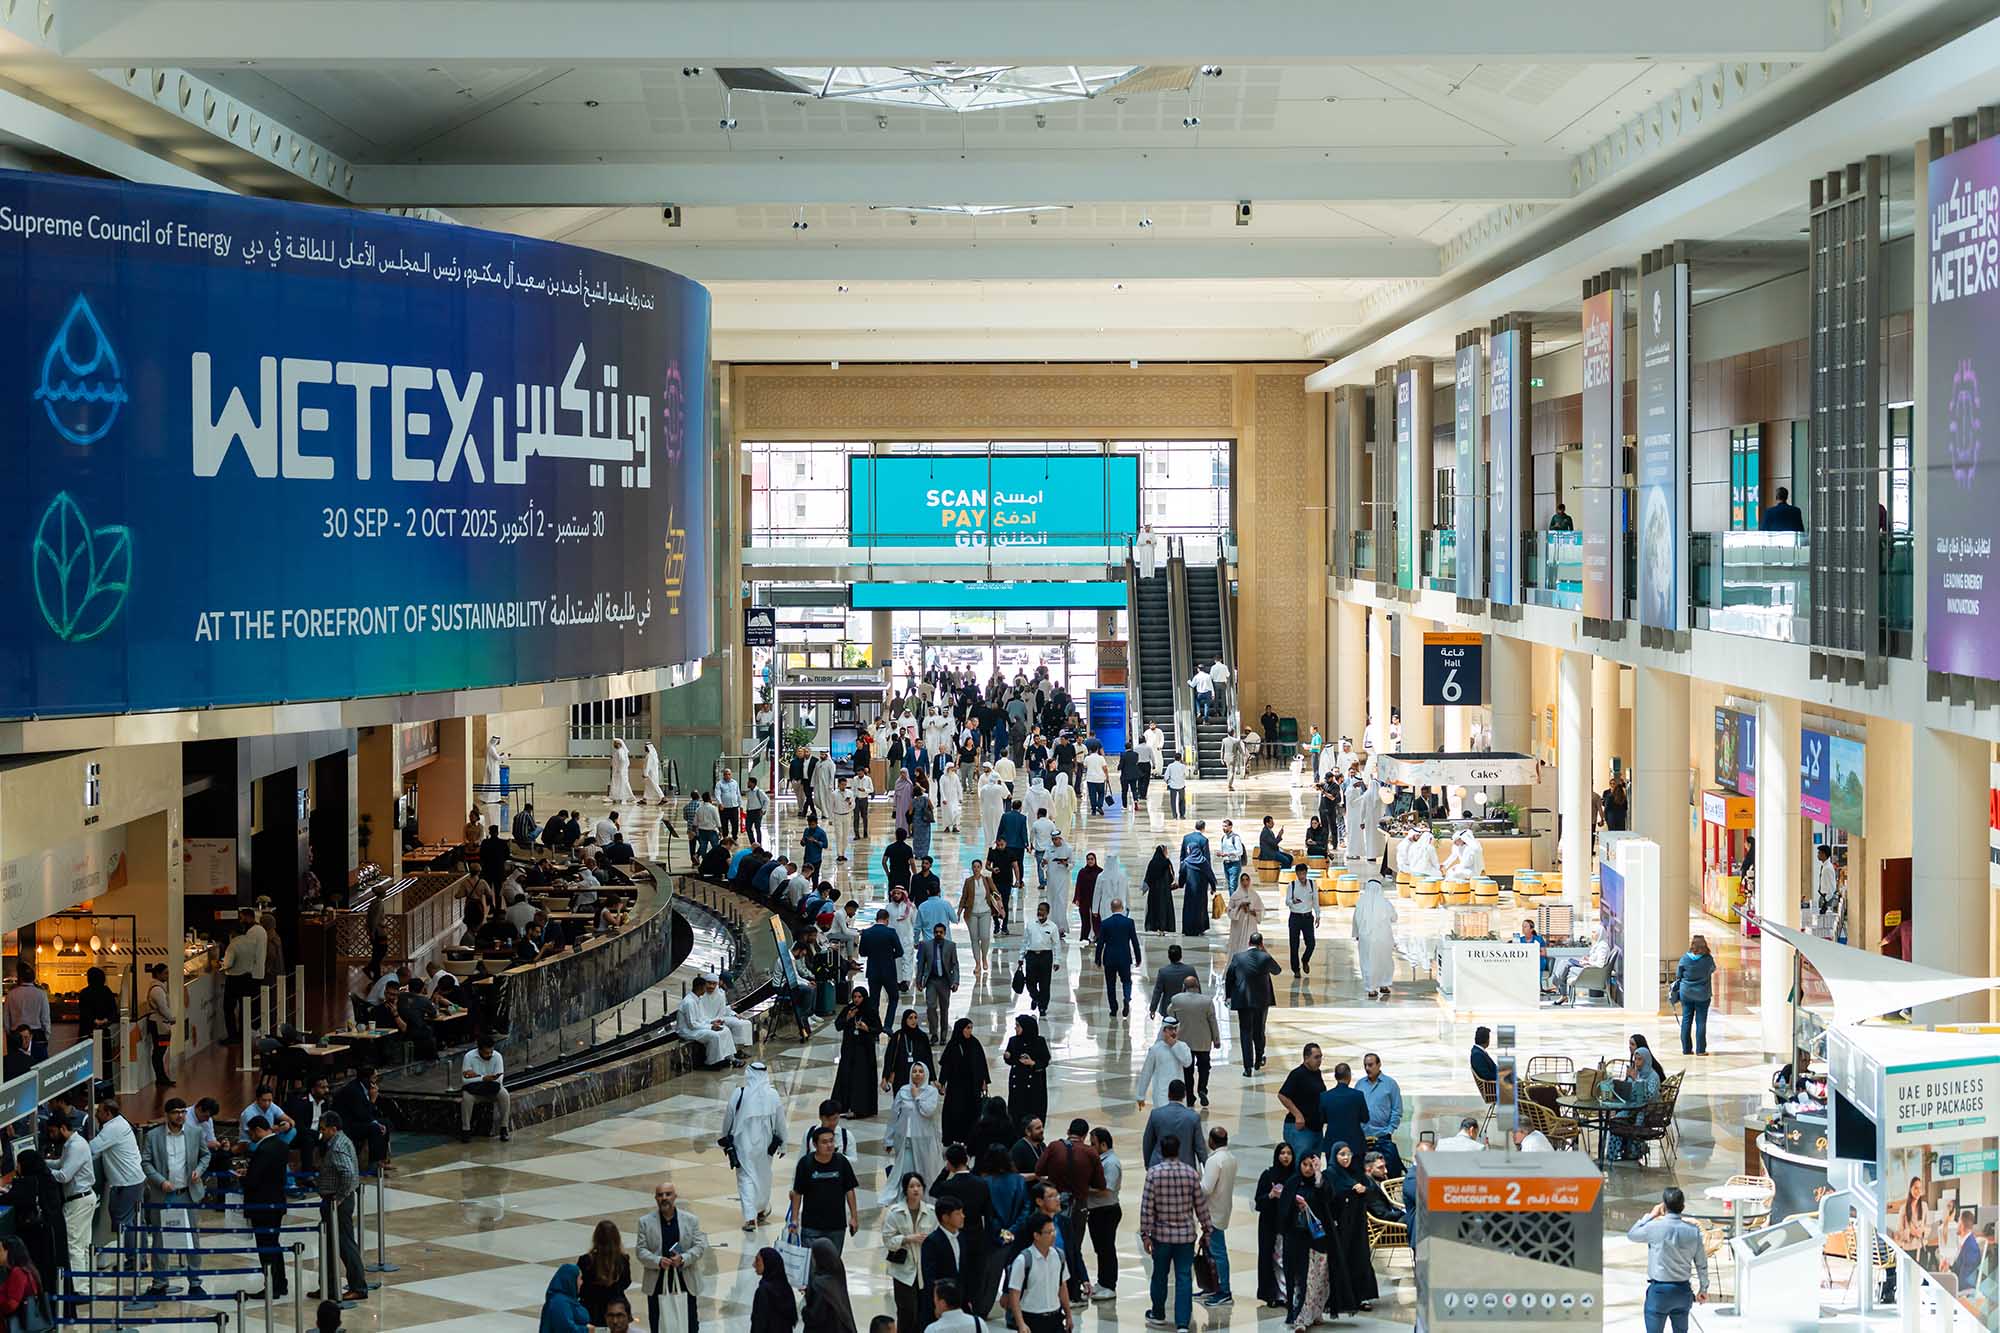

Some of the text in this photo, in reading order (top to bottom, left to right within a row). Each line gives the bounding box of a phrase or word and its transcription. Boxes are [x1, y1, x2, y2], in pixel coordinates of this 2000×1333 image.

[0, 206, 232, 257] Supreme Council of Energy
[242, 239, 264, 265] دبي
[268, 231, 282, 267] في
[285, 235, 336, 262] للطاقة
[338, 240, 376, 269] الأعلى
[378, 249, 430, 276] المجلس
[433, 257, 461, 282] رئيس
[504, 261, 515, 289] آل
[1931, 241, 1986, 305] WETEX
[516, 274, 546, 292] سعيد
[547, 278, 560, 297] بن
[561, 270, 583, 296] أحمد
[191, 351, 486, 484] WETEX
[493, 342, 651, 489] ويتكس
[926, 489, 987, 507] SCAN
[993, 490, 1043, 506] امسح
[322, 508, 348, 538] 30
[353, 508, 388, 538] SEP
[406, 508, 417, 538] 2
[421, 508, 456, 538] OCT
[461, 508, 498, 538] 2025
[499, 499, 535, 545] أكتوبر
[537, 510, 545, 537] 2
[556, 513, 591, 544] سبتمبر
[592, 510, 606, 538] 30
[942, 509, 986, 527] PAY
[993, 511, 1037, 527] ادفع
[955, 530, 987, 548] GO
[550, 589, 651, 635] في طليعة الاستدامة
[1947, 598, 1980, 616] INNOVATIONS
[195, 600, 547, 642] AT THE FOREFRONT OF SUSTAINABILITY
[1440, 648, 1465, 657] قاعة
[1442, 669, 1462, 702] 6
[1470, 769, 1499, 779] Cakes
[1468, 950, 1529, 958] TRUSSARDI
[1898, 1078, 1984, 1101] UAE BUSINESS
[1898, 1097, 1984, 1119] SET-UP PACKAGES
[1443, 1182, 1521, 1205] Concourse 2
